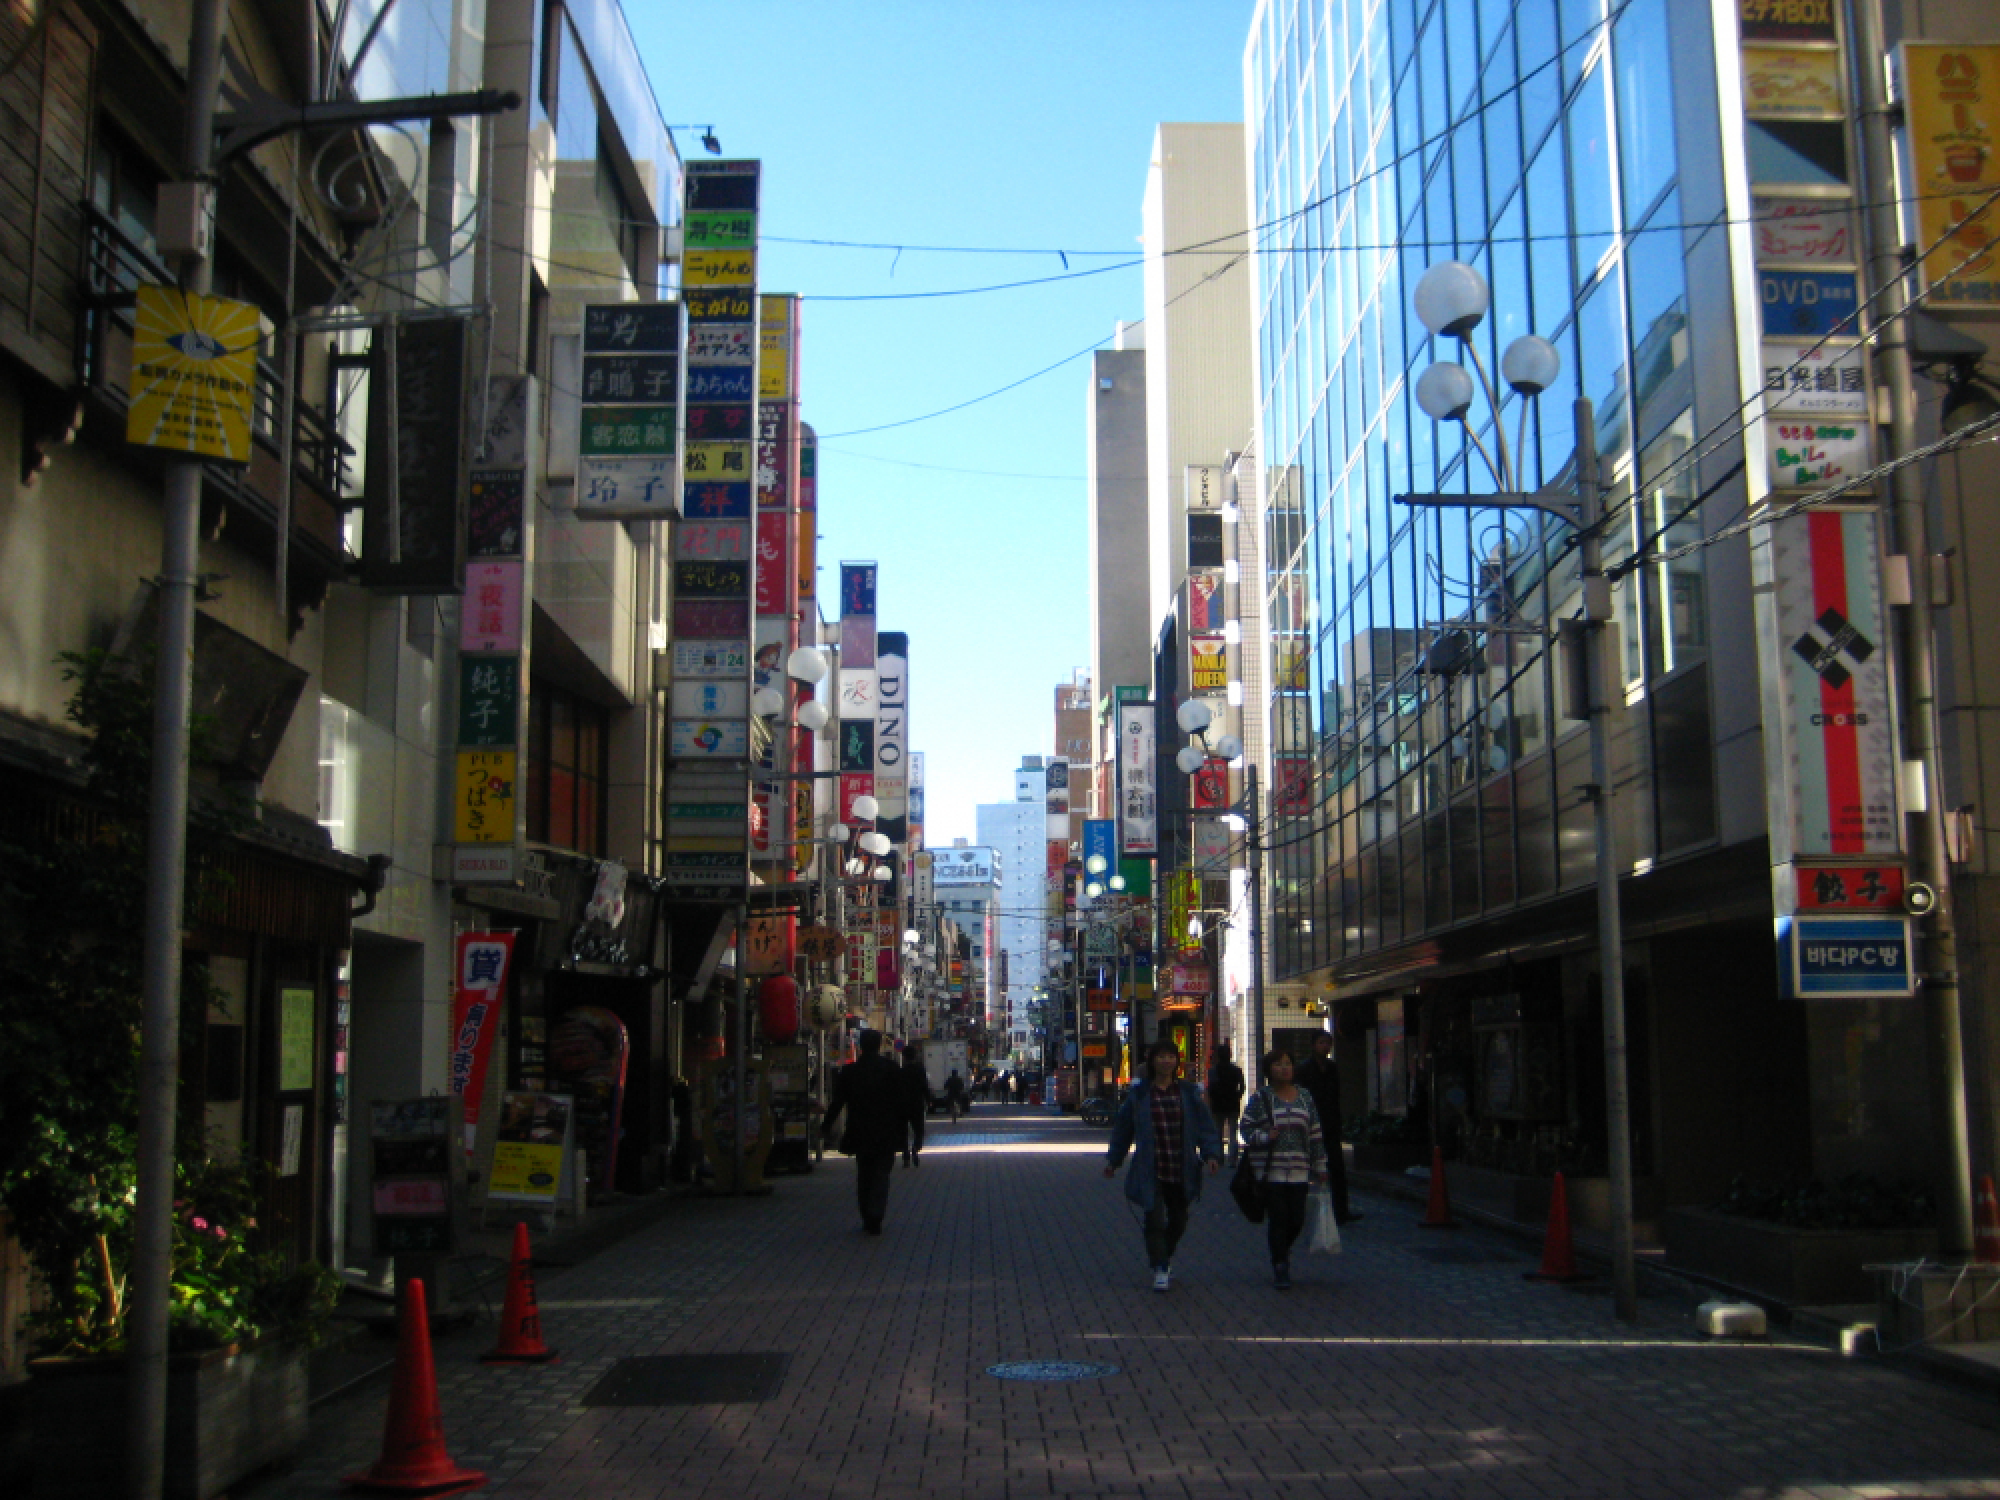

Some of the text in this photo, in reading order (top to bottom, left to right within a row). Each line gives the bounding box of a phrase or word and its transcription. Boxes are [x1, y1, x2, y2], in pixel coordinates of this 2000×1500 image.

[1763, 279, 1819, 304] DVD
[686, 451, 744, 471] 松尾
[1811, 624, 1858, 672] CROSS
[469, 665, 501, 730] 純子
[878, 675, 905, 767] DINO
[1810, 713, 1868, 726] CROSS
